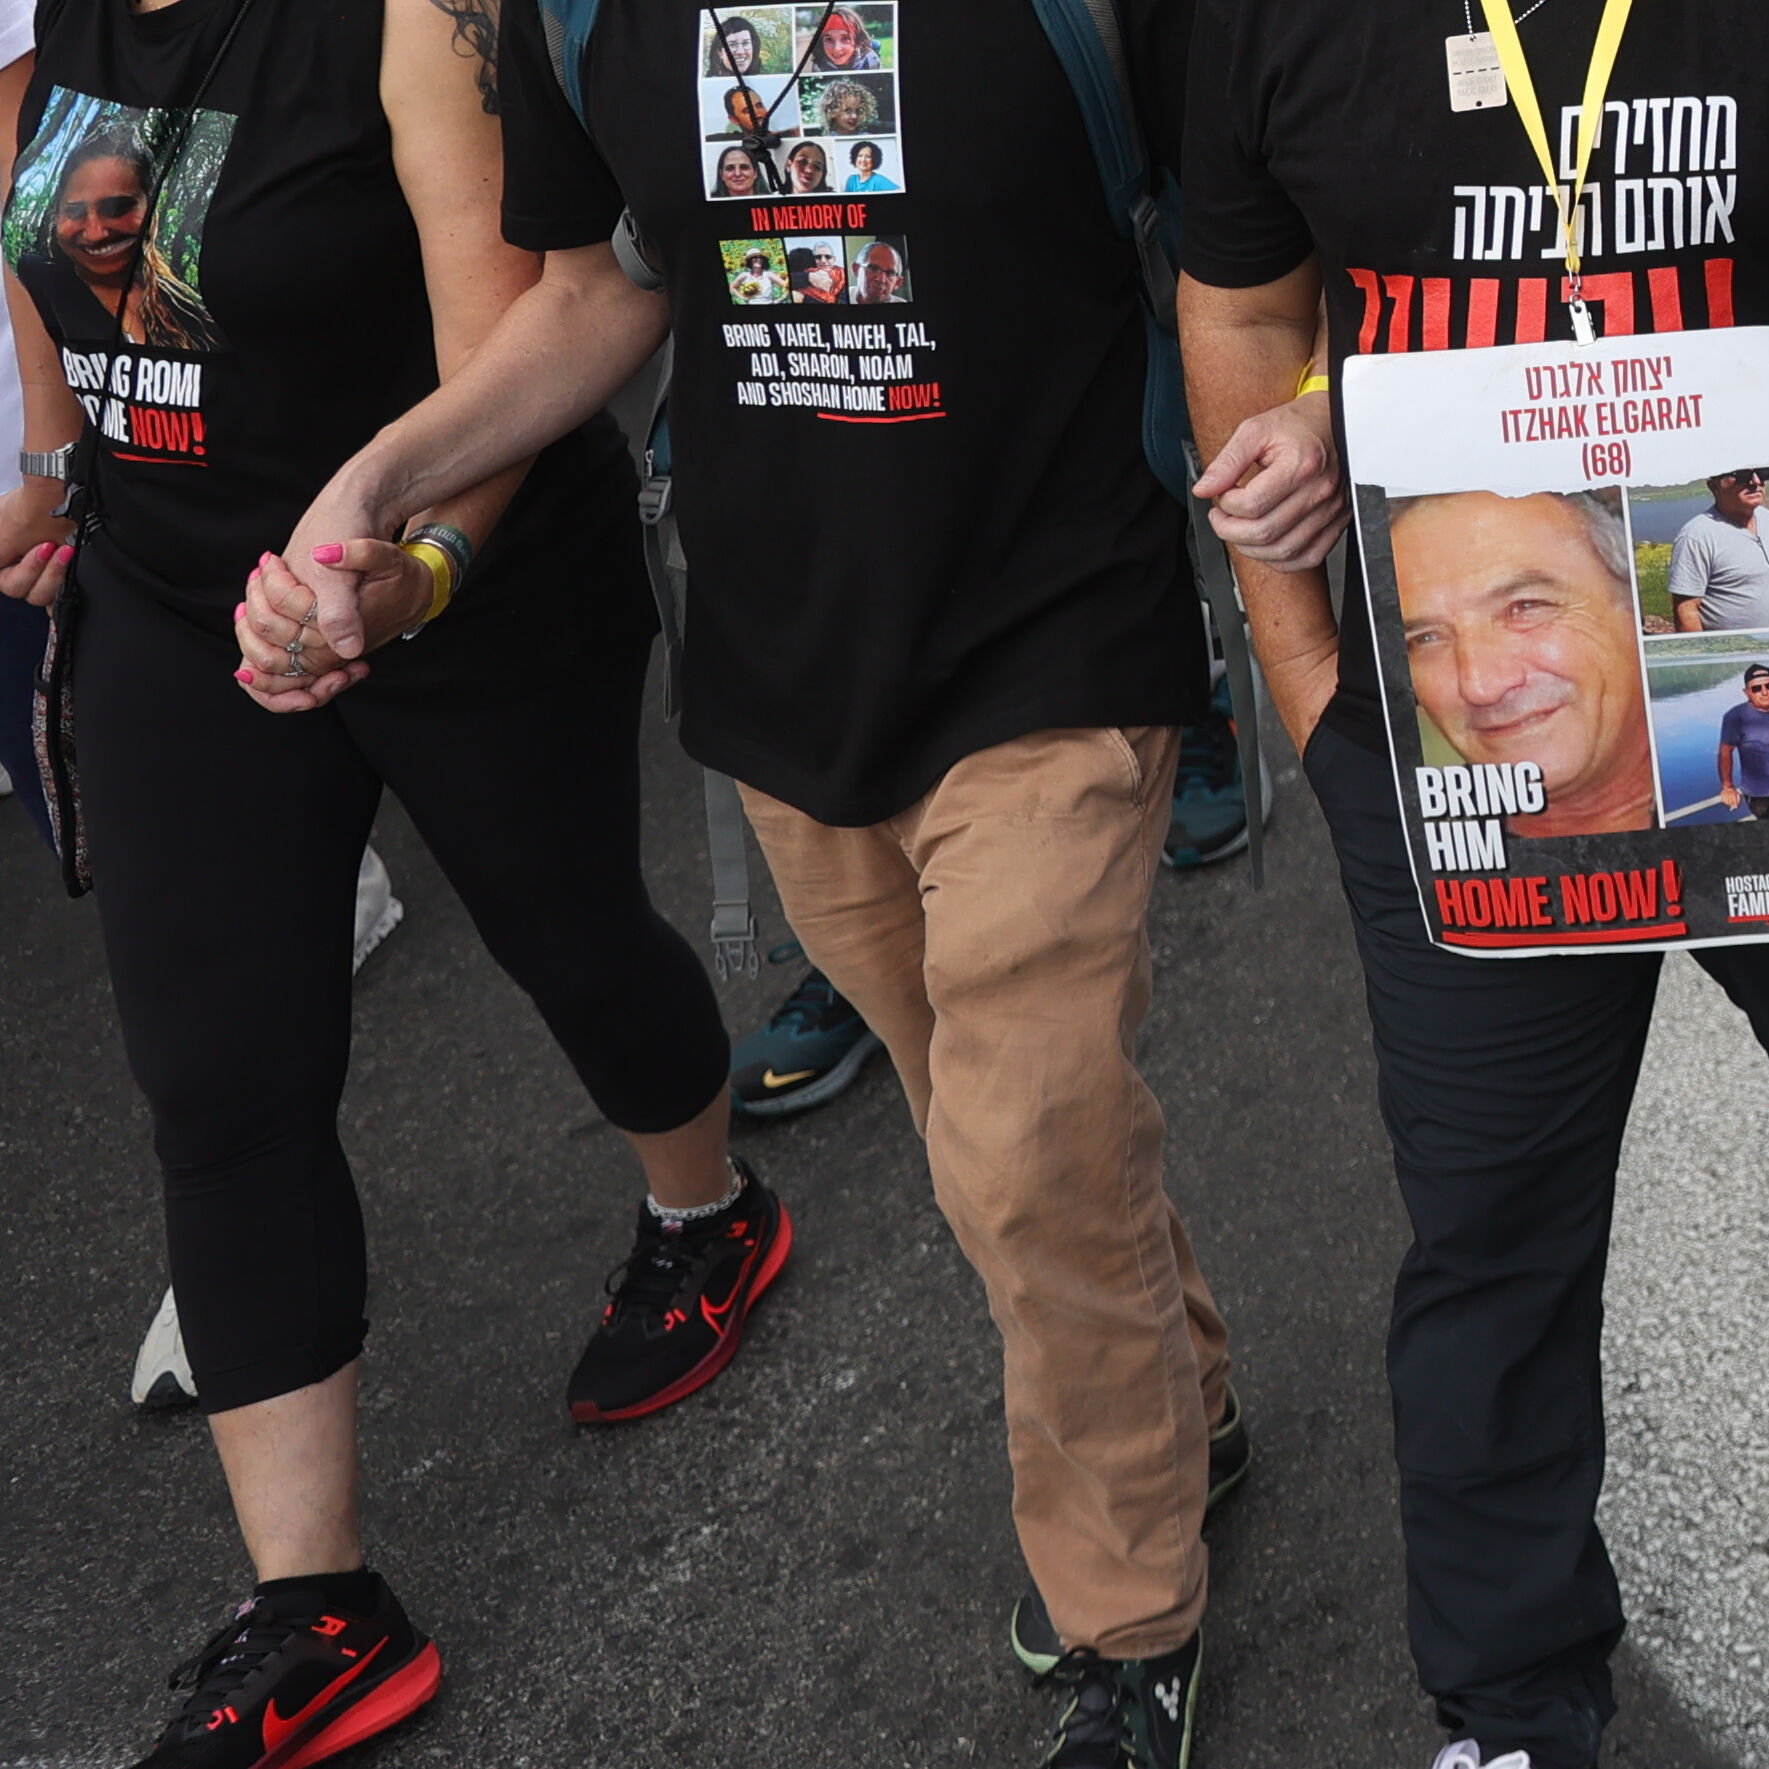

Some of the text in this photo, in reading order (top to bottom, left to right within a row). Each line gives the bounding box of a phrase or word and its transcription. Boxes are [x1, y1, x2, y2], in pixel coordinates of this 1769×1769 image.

[1559, 96, 1738, 181] מחזירים
[751, 203, 867, 232] IN MEMORY OF
[1453, 173, 1738, 261] אותם הביתה
[721, 322, 937, 353] BRING YAHEL, NAVEH, TAL,
[62, 346, 202, 408] BRING ROMI
[751, 352, 914, 385] ADI, SHARON, NOAM
[1524, 355, 1673, 401] יצחק אלגרט
[737, 381, 941, 412] AND SHOSHAN HOME NOW!
[1501, 393, 1703, 444] ITZHAK ELGARAT
[75, 393, 206, 456] OME NOW!
[1582, 439, 1631, 481] (68)
[1414, 760, 1547, 819] BRING
[1423, 819, 1507, 872] HIM
[1434, 859, 1683, 928] HOME NOW!
